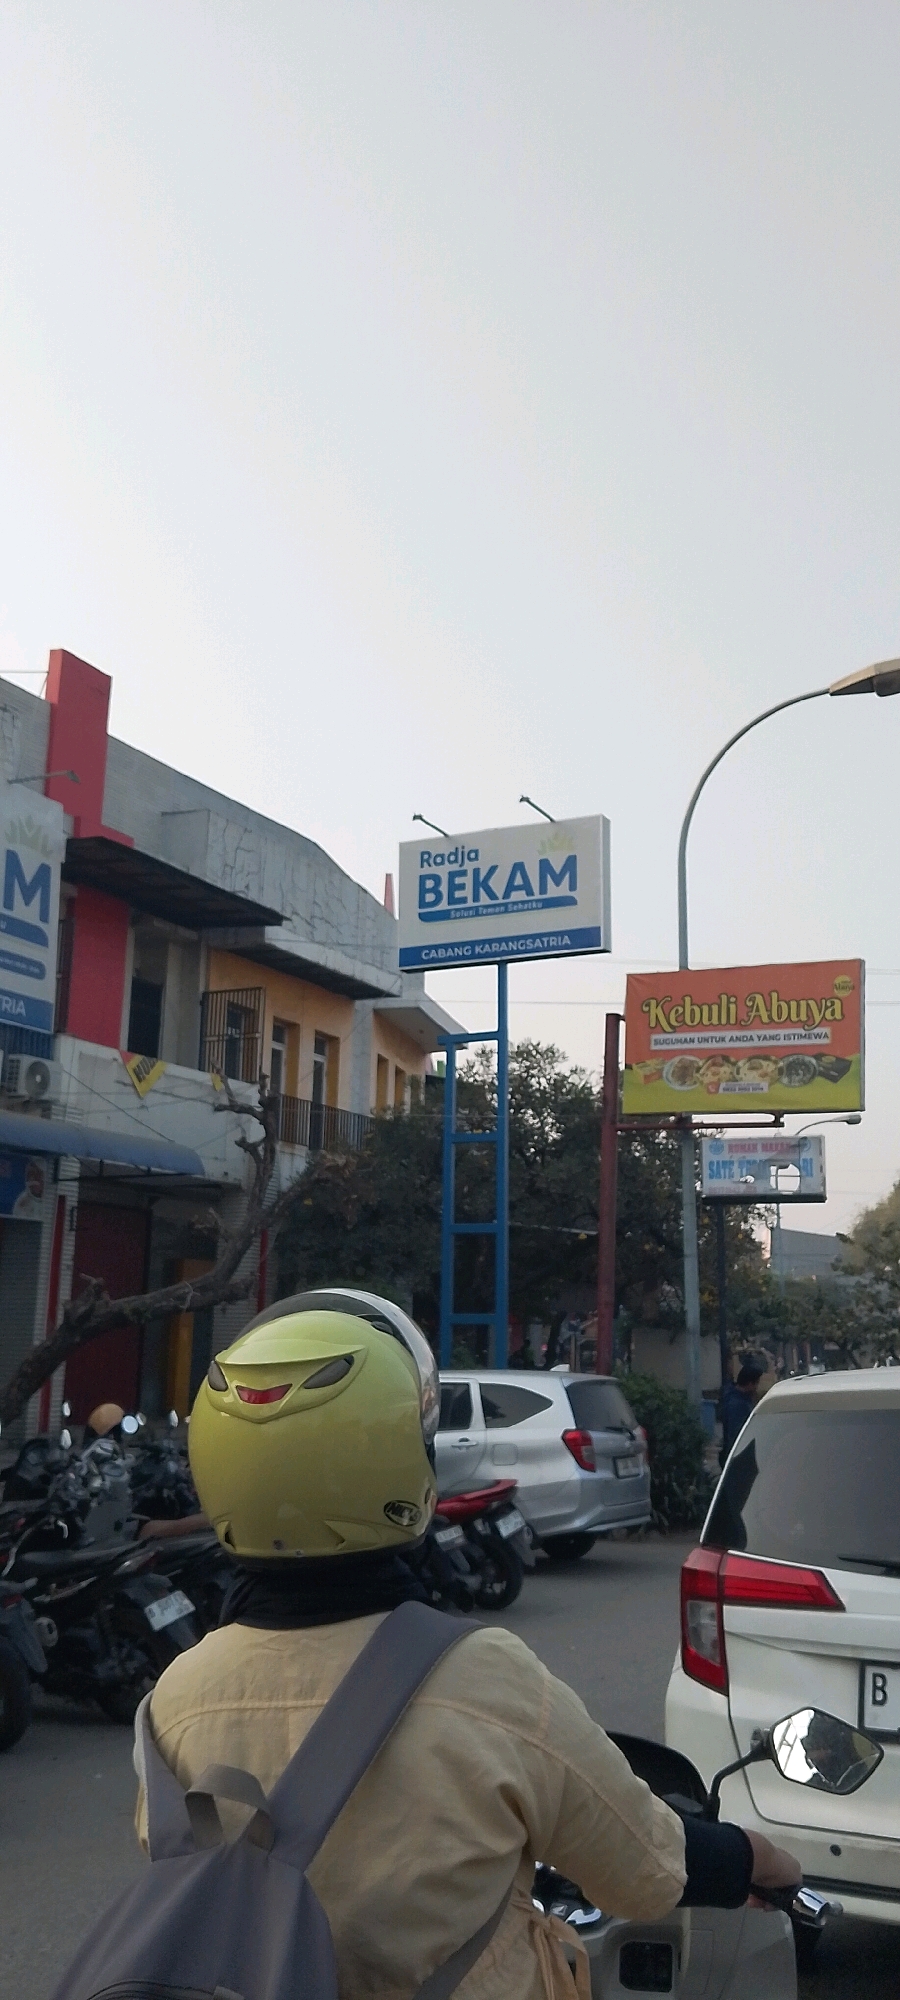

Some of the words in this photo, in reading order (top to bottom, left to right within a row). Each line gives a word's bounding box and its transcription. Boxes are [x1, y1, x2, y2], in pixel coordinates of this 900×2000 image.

[420, 846, 480, 868] Radja
[418, 854, 578, 910] BEKAM
[450, 910, 476, 919] Solusi
[507, 901, 543, 912] Sehatku
[421, 945, 472, 960] CABANG
[474, 935, 571, 955] KARANGSATRIA
[641, 993, 739, 1033] Kebuli
[740, 990, 845, 1031] Abuya
[653, 1037, 696, 1047] SUGUHAN
[697, 1035, 727, 1045] UNTUK
[728, 1034, 755, 1043] ANDA
[756, 1033, 782, 1042] YANG
[783, 1031, 830, 1041] ISTIMEWA
[871, 1672, 888, 1706] B
